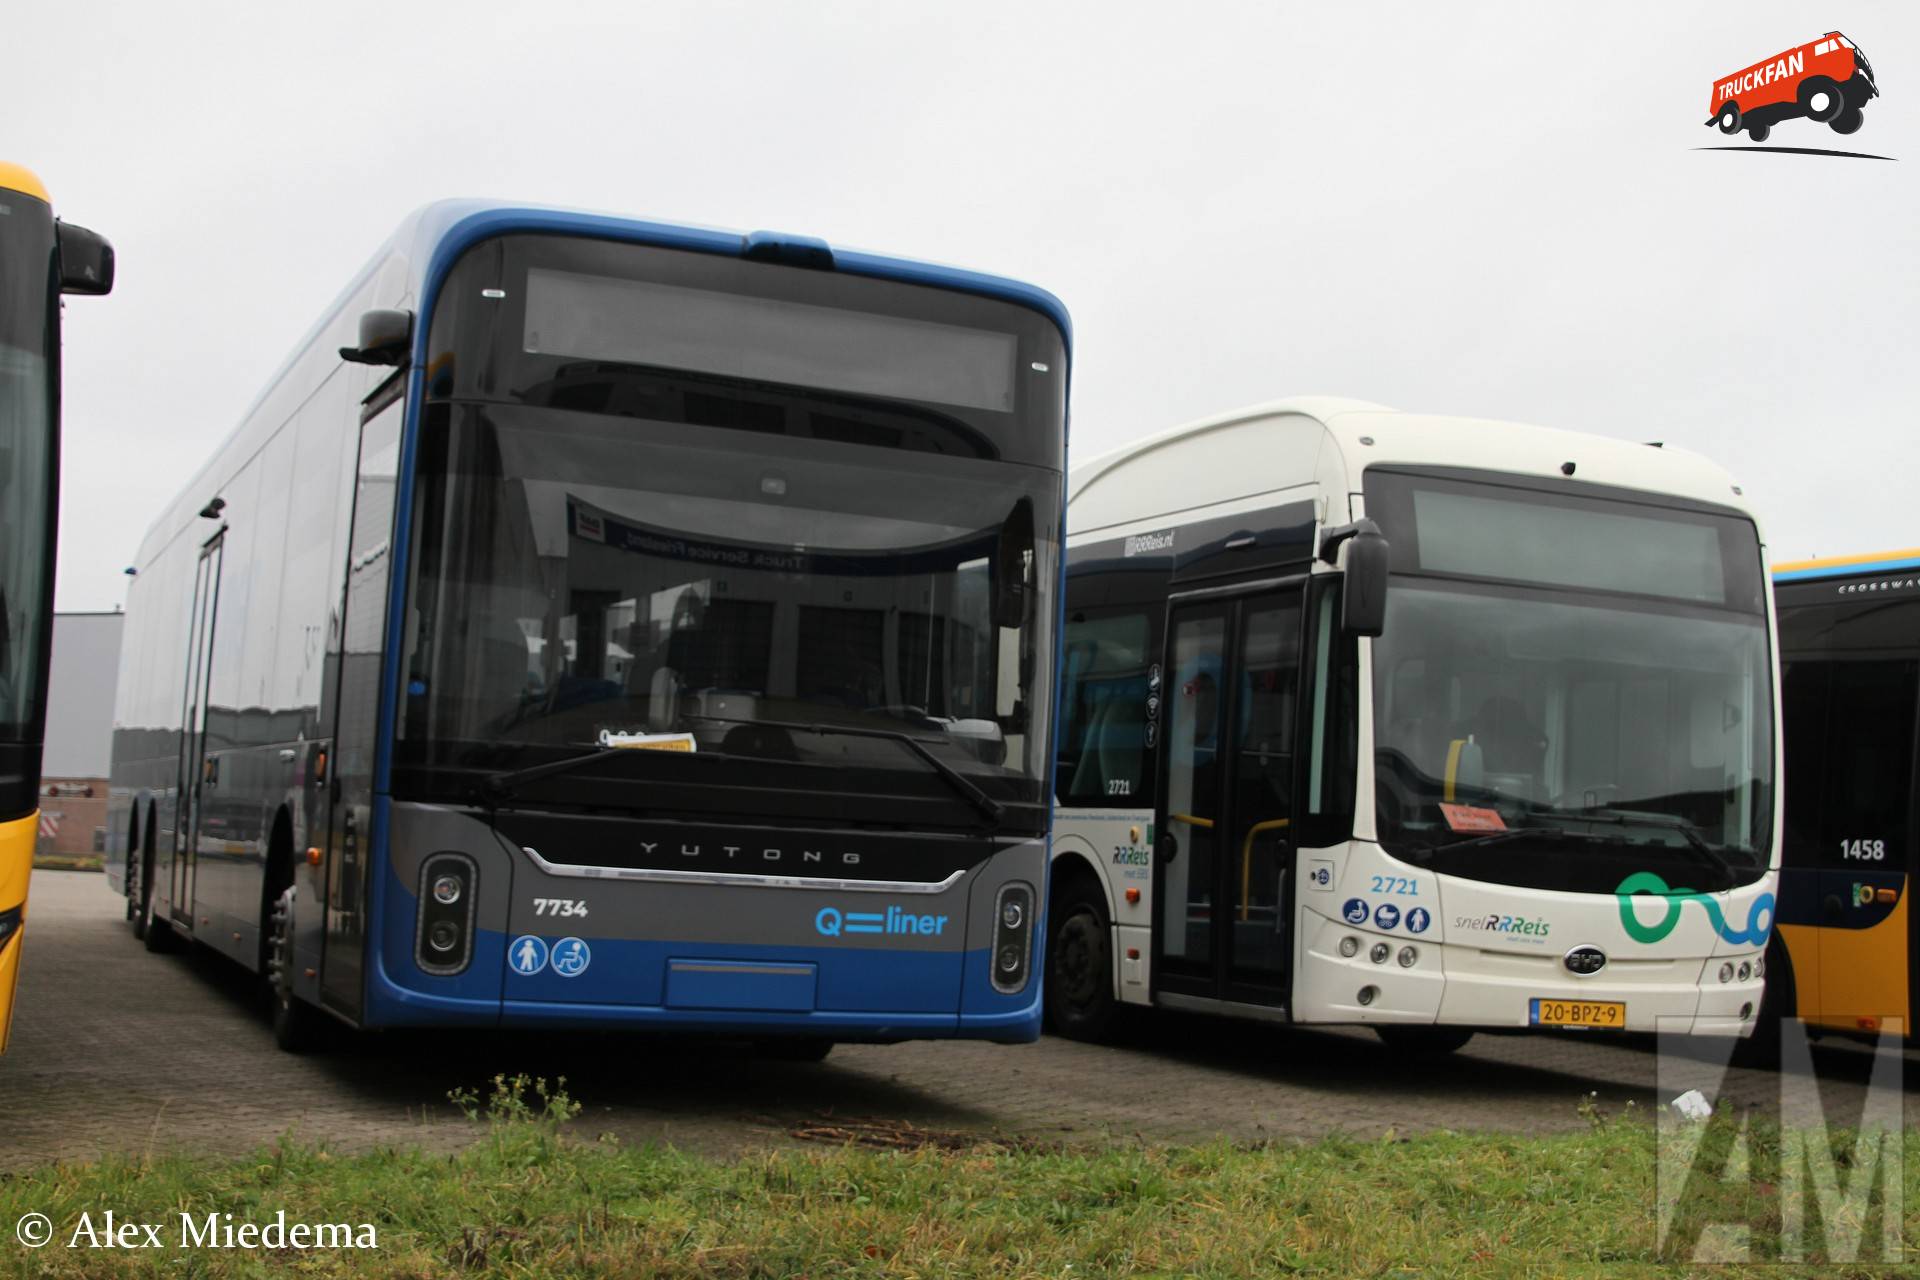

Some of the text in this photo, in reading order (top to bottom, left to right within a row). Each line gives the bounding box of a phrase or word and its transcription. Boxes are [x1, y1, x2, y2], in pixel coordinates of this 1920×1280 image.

[1107, 779, 1131, 795] 2721
[641, 842, 860, 864] YUTONG
[1840, 839, 1884, 860] 1458
[1371, 876, 1418, 895] 2721
[533, 898, 588, 917] 7734
[1543, 1003, 1617, 1023] 20-BPZ-9
